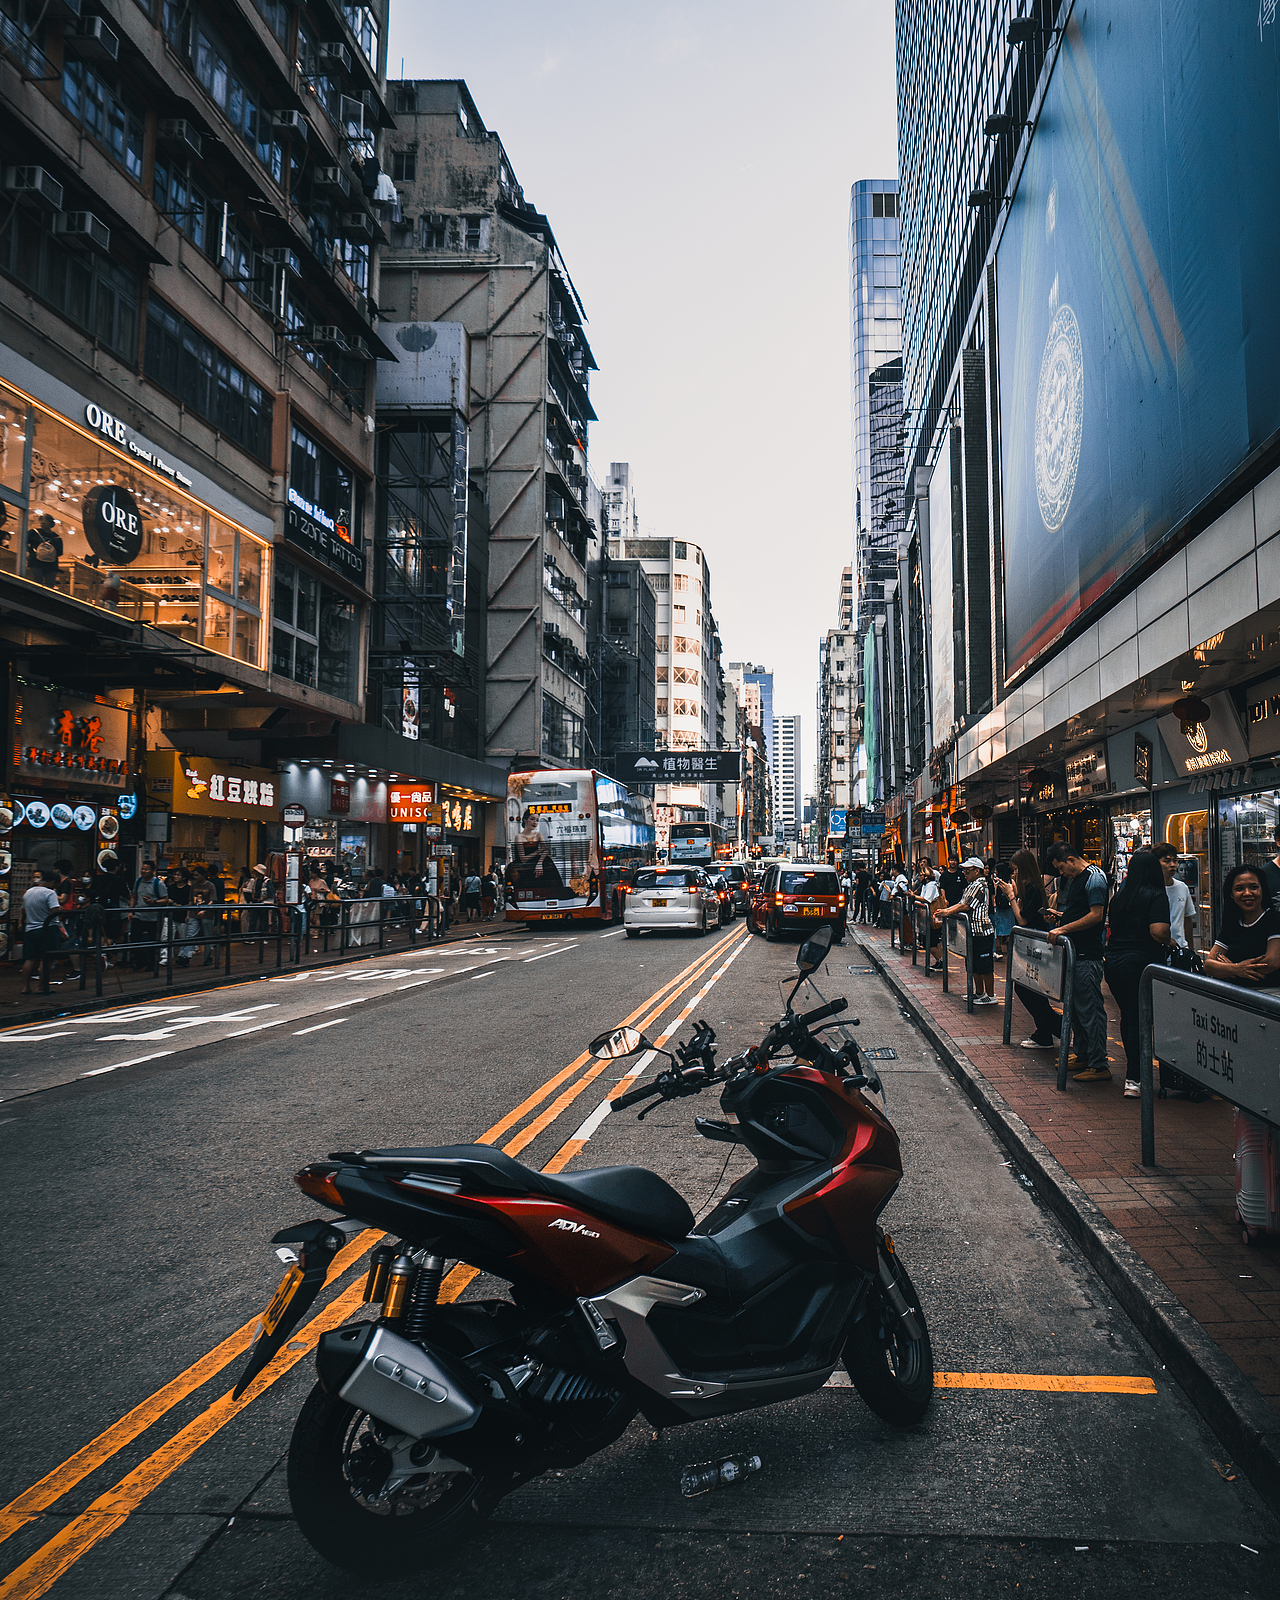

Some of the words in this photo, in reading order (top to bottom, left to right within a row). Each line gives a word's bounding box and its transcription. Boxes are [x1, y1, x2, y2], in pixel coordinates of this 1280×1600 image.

[86, 403, 126, 445] ORE
[101, 501, 138, 536] ORE
[330, 538, 363, 572] TATTOO
[58, 709, 105, 753] 香港
[662, 757, 718, 771] 植物醫生
[209, 773, 274, 807] 紅豆烘焙
[390, 791, 432, 803] 優一尚品
[269, 968, 445, 983] STOP
[1191, 1007, 1208, 1031] Taxi
[1210, 1015, 1238, 1044] Stand
[1196, 1039, 1234, 1084] 的士站
[547, 1217, 587, 1233] ADV
